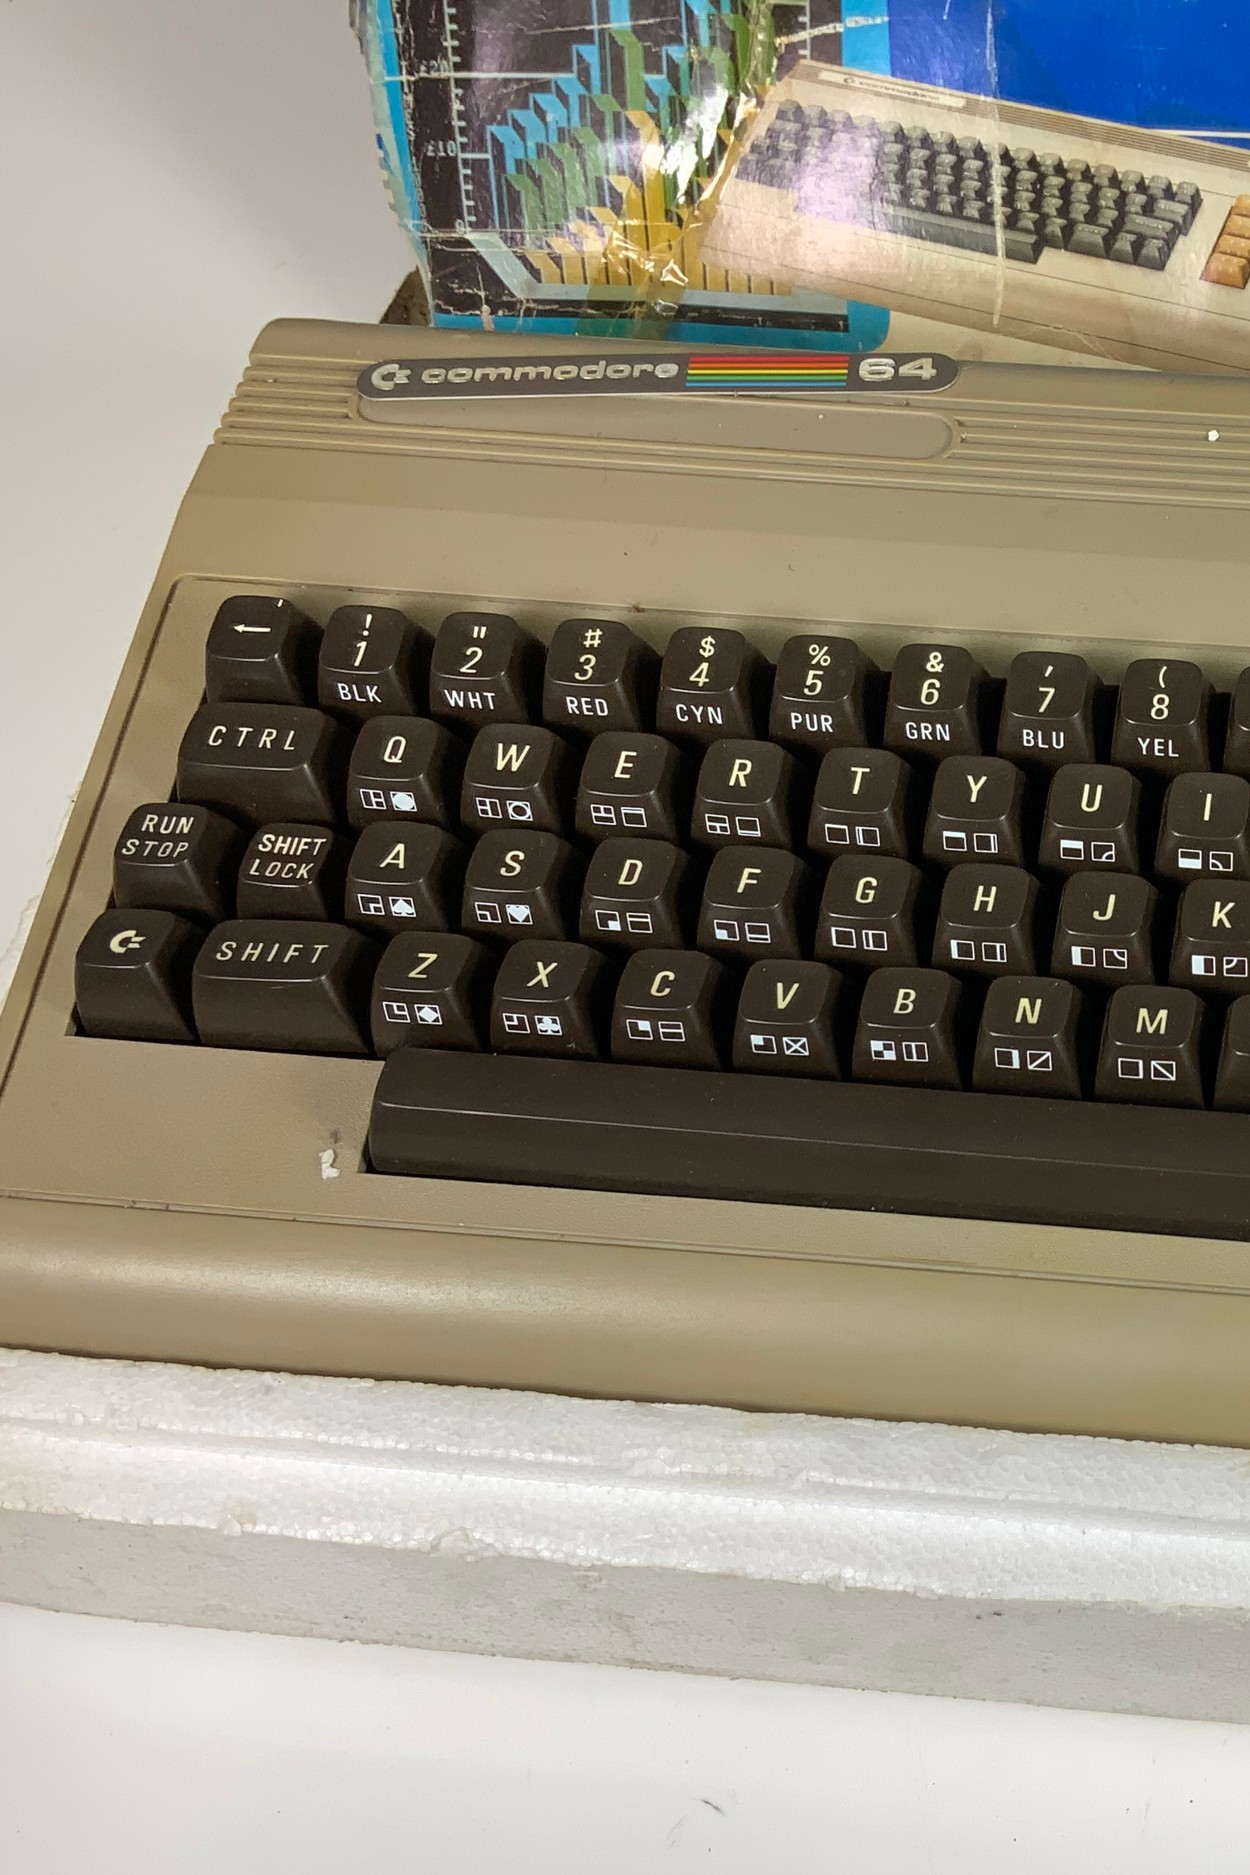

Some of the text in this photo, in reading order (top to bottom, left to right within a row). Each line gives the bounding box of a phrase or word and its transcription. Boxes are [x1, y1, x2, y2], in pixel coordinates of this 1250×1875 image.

[426, 140, 458, 157] £10
[421, 356, 938, 386] commodore 64
[363, 614, 372, 636] !
[473, 626, 486, 638] "
[584, 629, 602, 647] #
[700, 636, 715, 657] $
[354, 641, 367, 666] 1
[460, 647, 482, 673] 2
[809, 644, 830, 666] %
[926, 652, 944, 672] &
[575, 654, 596, 680] 3
[690, 662, 709, 686] 4
[1159, 666, 1167, 688] (
[338, 683, 381, 702] BLK
[804, 670, 823, 695] 5
[921, 679, 940, 705] 6
[444, 690, 495, 709] WHT
[566, 697, 608, 716] RED
[1039, 687, 1055, 712] 7
[1151, 694, 1169, 719] 8
[676, 704, 722, 724] CYN
[791, 713, 833, 732] PUR
[209, 726, 294, 750] CTRL
[906, 722, 950, 740] GRN
[1023, 729, 1063, 748] BLU
[384, 736, 406, 763] Q
[497, 743, 530, 771] W
[1138, 738, 1179, 757] YEL
[615, 751, 637, 778] E
[729, 759, 752, 786] R
[851, 767, 870, 794] T
[967, 775, 987, 802] Y
[1081, 784, 1102, 812] U
[1204, 794, 1212, 821] I
[142, 815, 194, 834] RUN
[122, 839, 188, 857] STOP
[258, 834, 326, 855] SHIFT
[380, 844, 404, 868] A
[250, 859, 313, 878] LOCK
[500, 851, 524, 876] S
[619, 860, 642, 885] D
[737, 868, 761, 893] F
[856, 877, 877, 903] G
[974, 886, 996, 912] H
[1093, 894, 1115, 920] J
[1213, 902, 1235, 928] K
[216, 942, 328, 963] SHIFT
[408, 953, 437, 978] Z
[527, 962, 557, 987] X
[651, 971, 675, 996] C
[777, 983, 799, 1009] V
[894, 989, 916, 1013] B
[1016, 998, 1042, 1023] N
[1136, 1008, 1168, 1034] M
